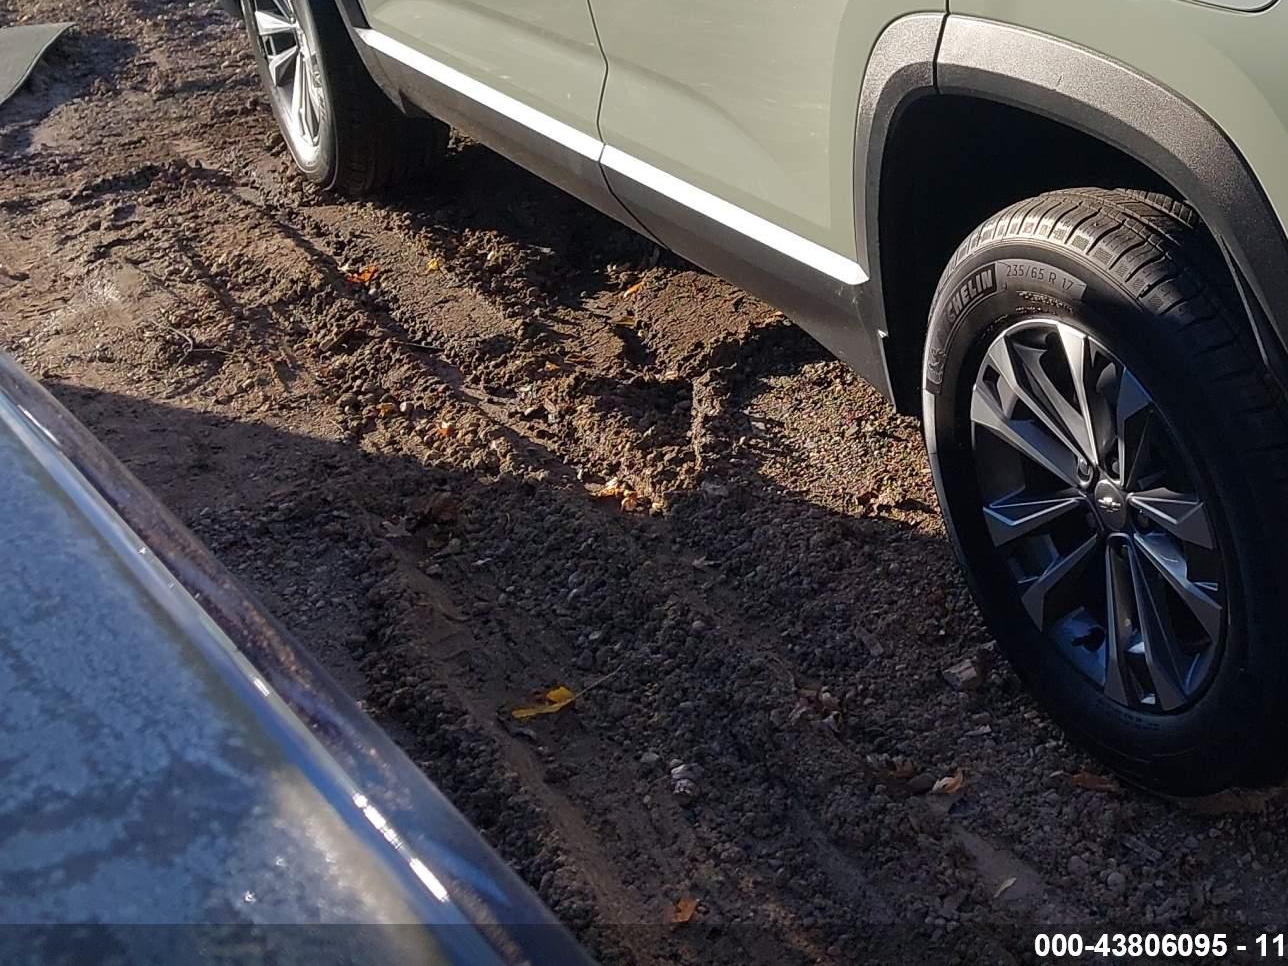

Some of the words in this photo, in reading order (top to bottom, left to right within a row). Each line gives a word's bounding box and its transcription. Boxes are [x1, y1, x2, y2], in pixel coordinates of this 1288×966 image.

[1005, 264, 1046, 281] 235/65
[1048, 272, 1057, 284] R
[1061, 280, 1074, 290] 17
